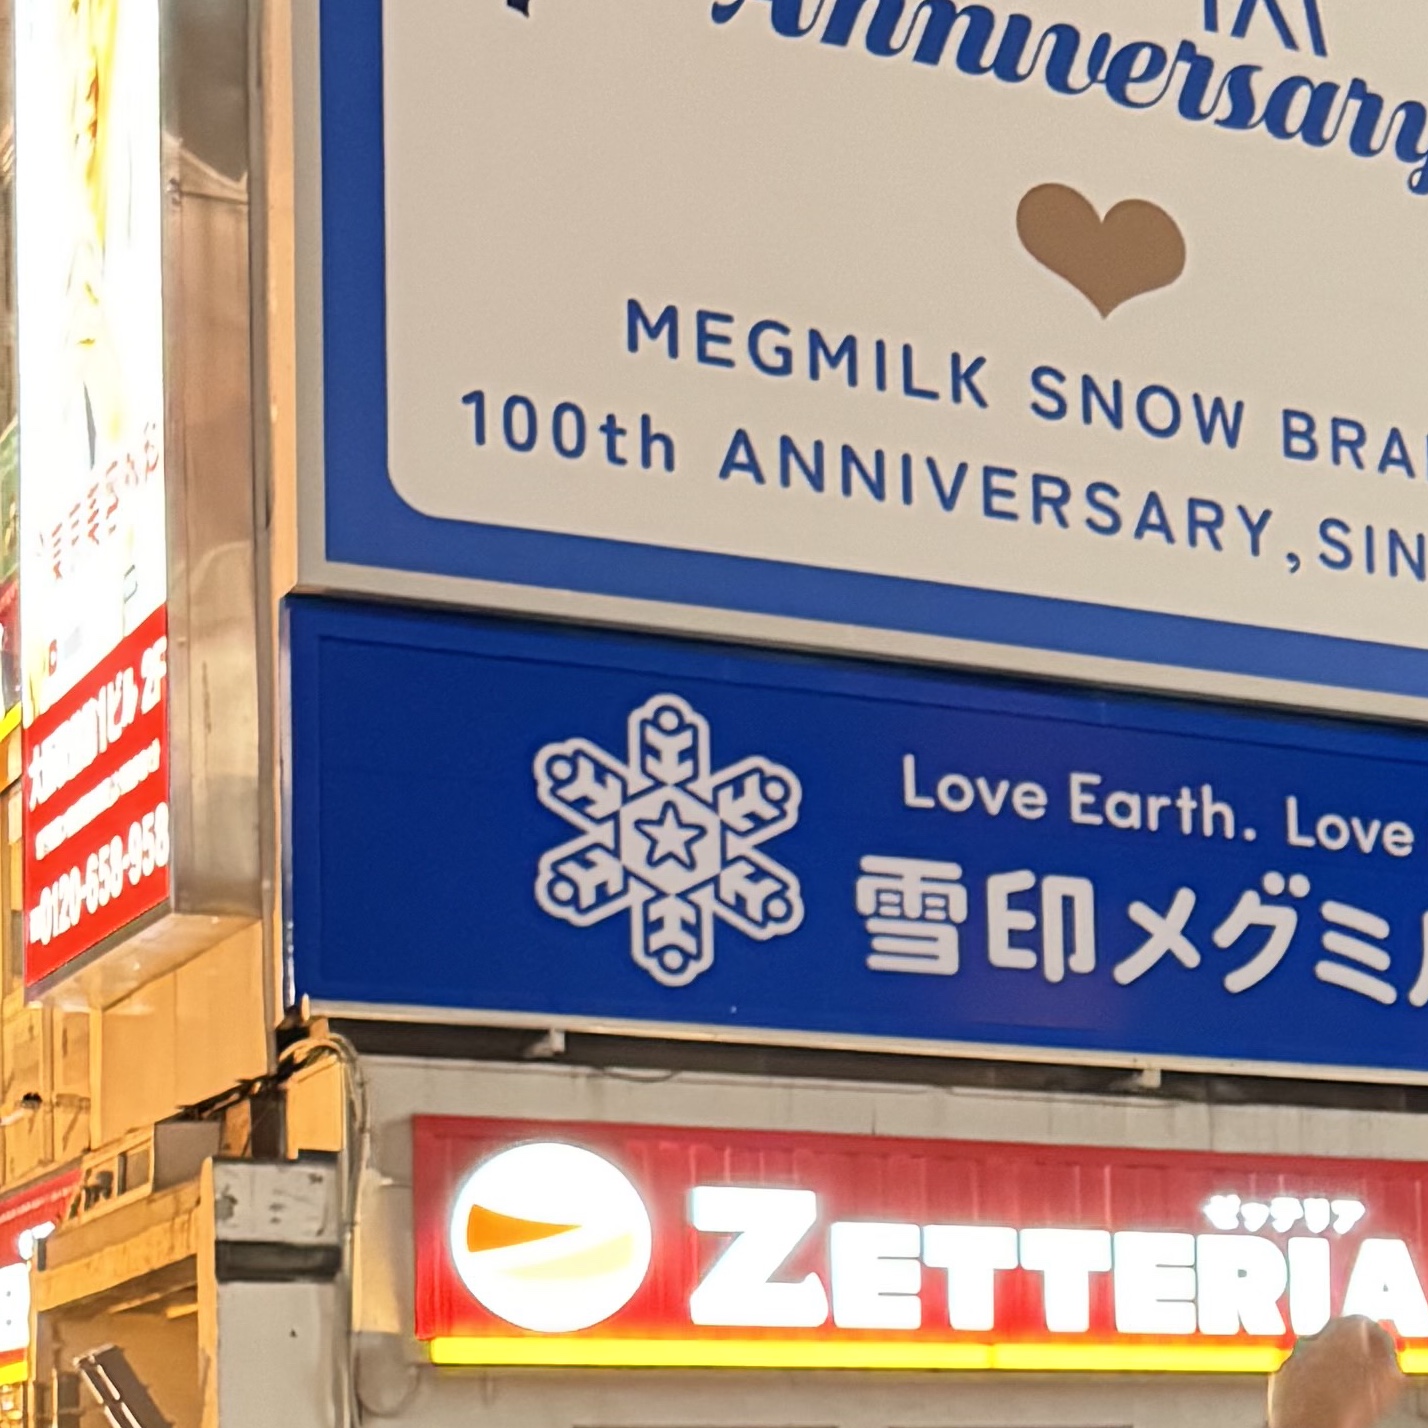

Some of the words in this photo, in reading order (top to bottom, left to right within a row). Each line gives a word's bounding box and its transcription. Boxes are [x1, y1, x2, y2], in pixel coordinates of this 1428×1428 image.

[626, 298, 989, 409] MEGMILK
[1029, 365, 1245, 450] SNOW
[460, 389, 676, 473] 100th
[902, 753, 1048, 820] Love
[1070, 772, 1257, 842] Earth.
[1286, 796, 1415, 857] Love
